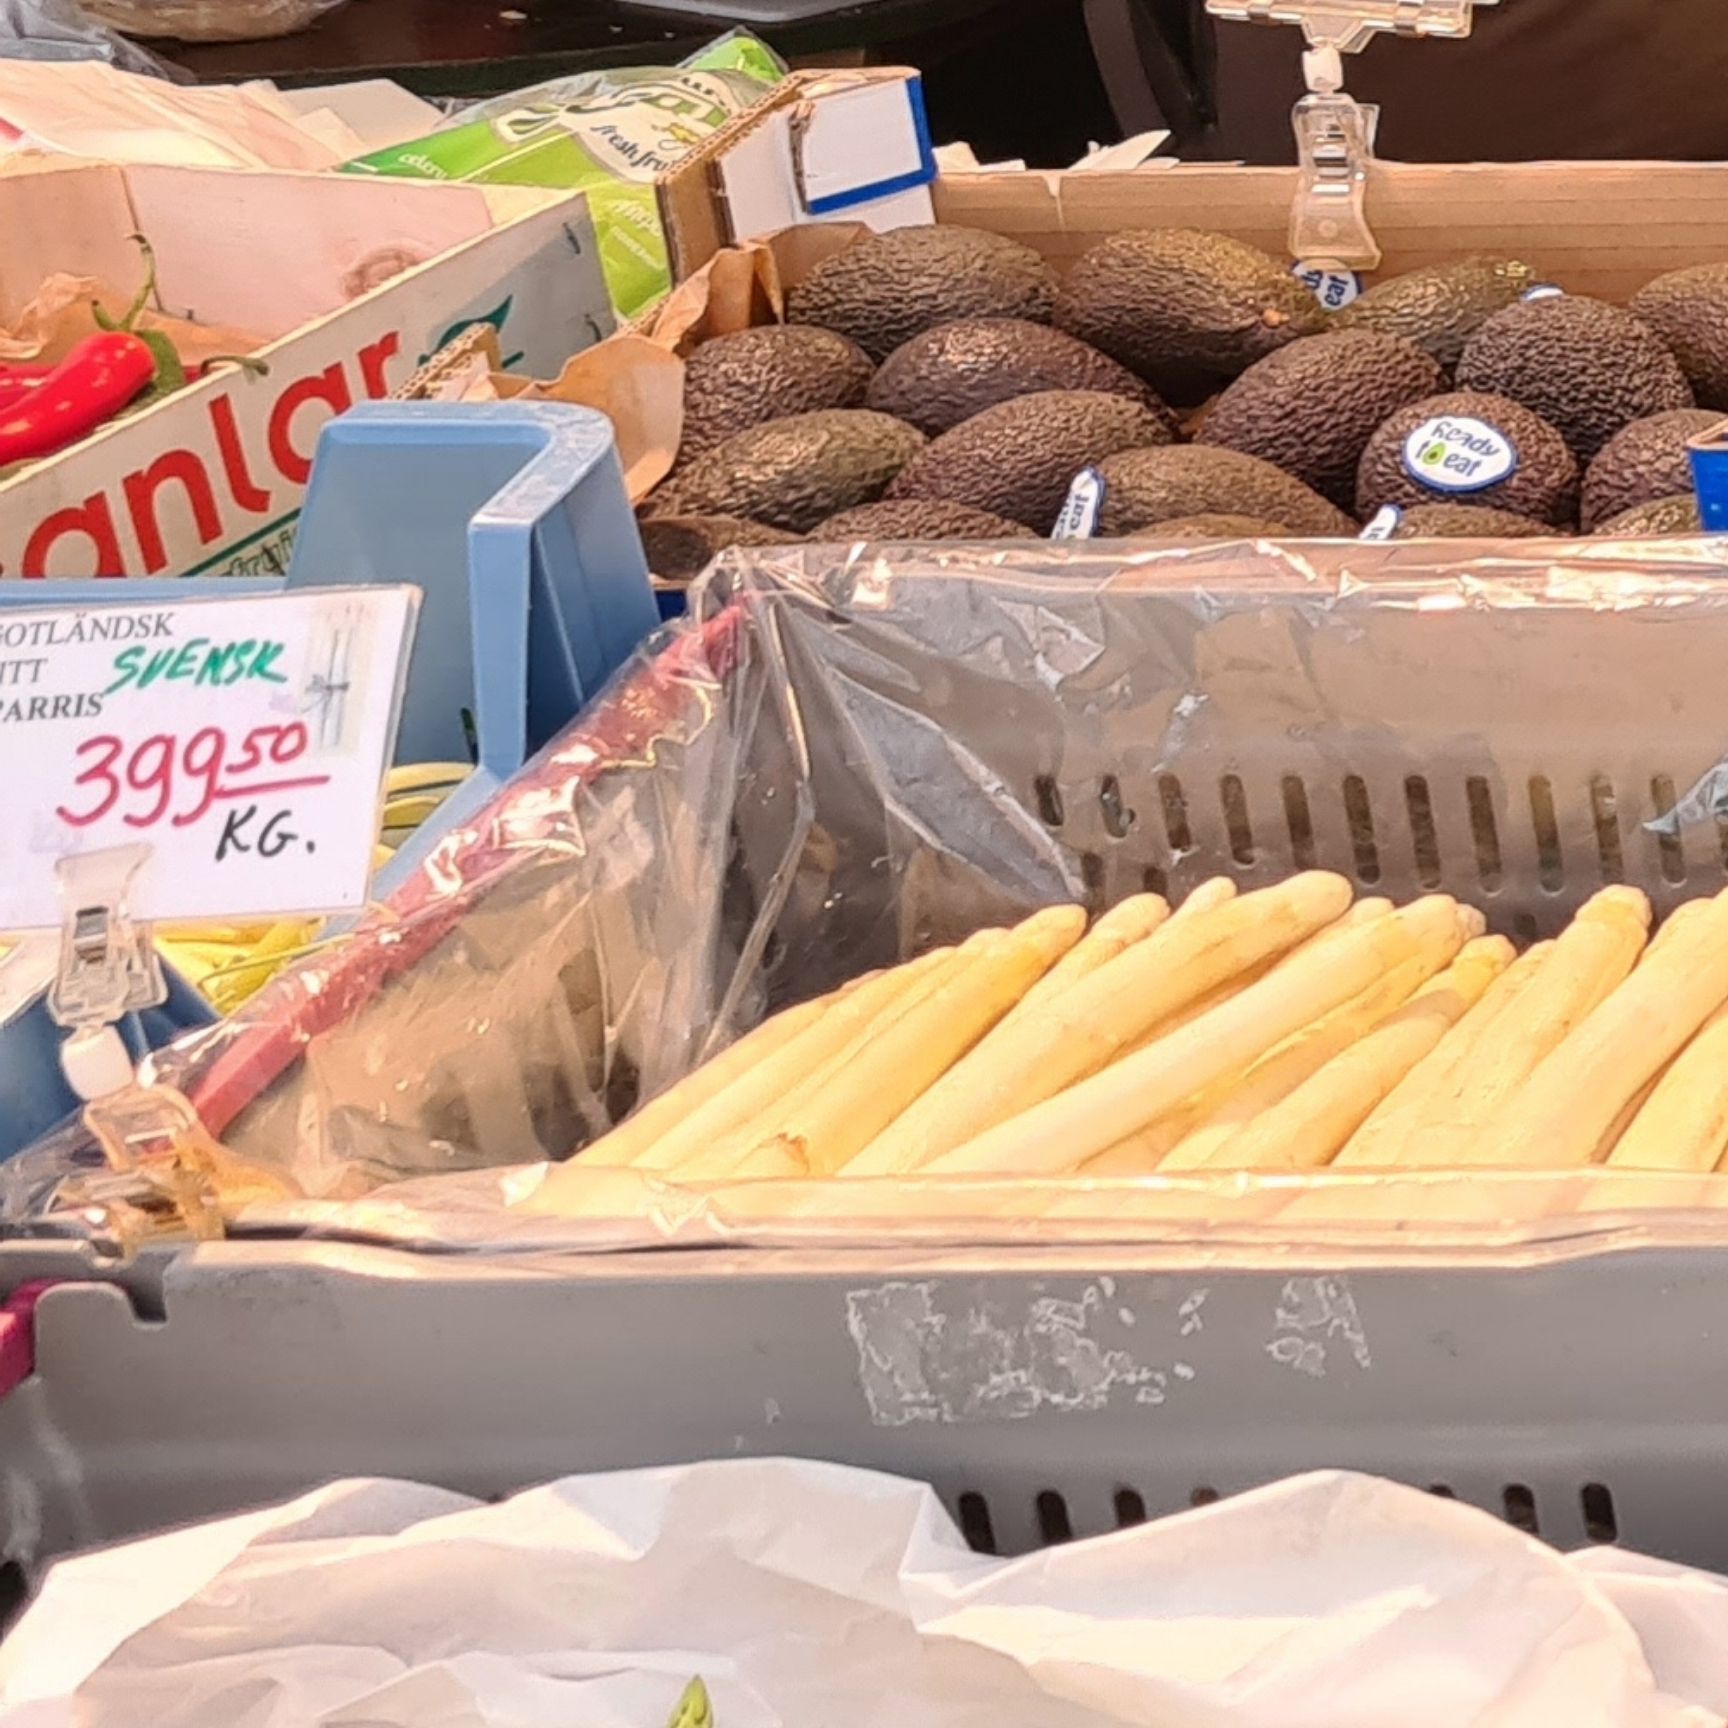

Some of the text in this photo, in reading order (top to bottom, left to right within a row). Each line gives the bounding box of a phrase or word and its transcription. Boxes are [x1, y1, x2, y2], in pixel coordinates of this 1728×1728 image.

[0, 331, 399, 578] anlar
[1431, 420, 1501, 457] Ready
[1443, 452, 1483, 478] eat
[0, 611, 175, 648] OTLÄNDSK
[103, 638, 289, 695] SVENSK
[0, 692, 103, 723] ARRIS
